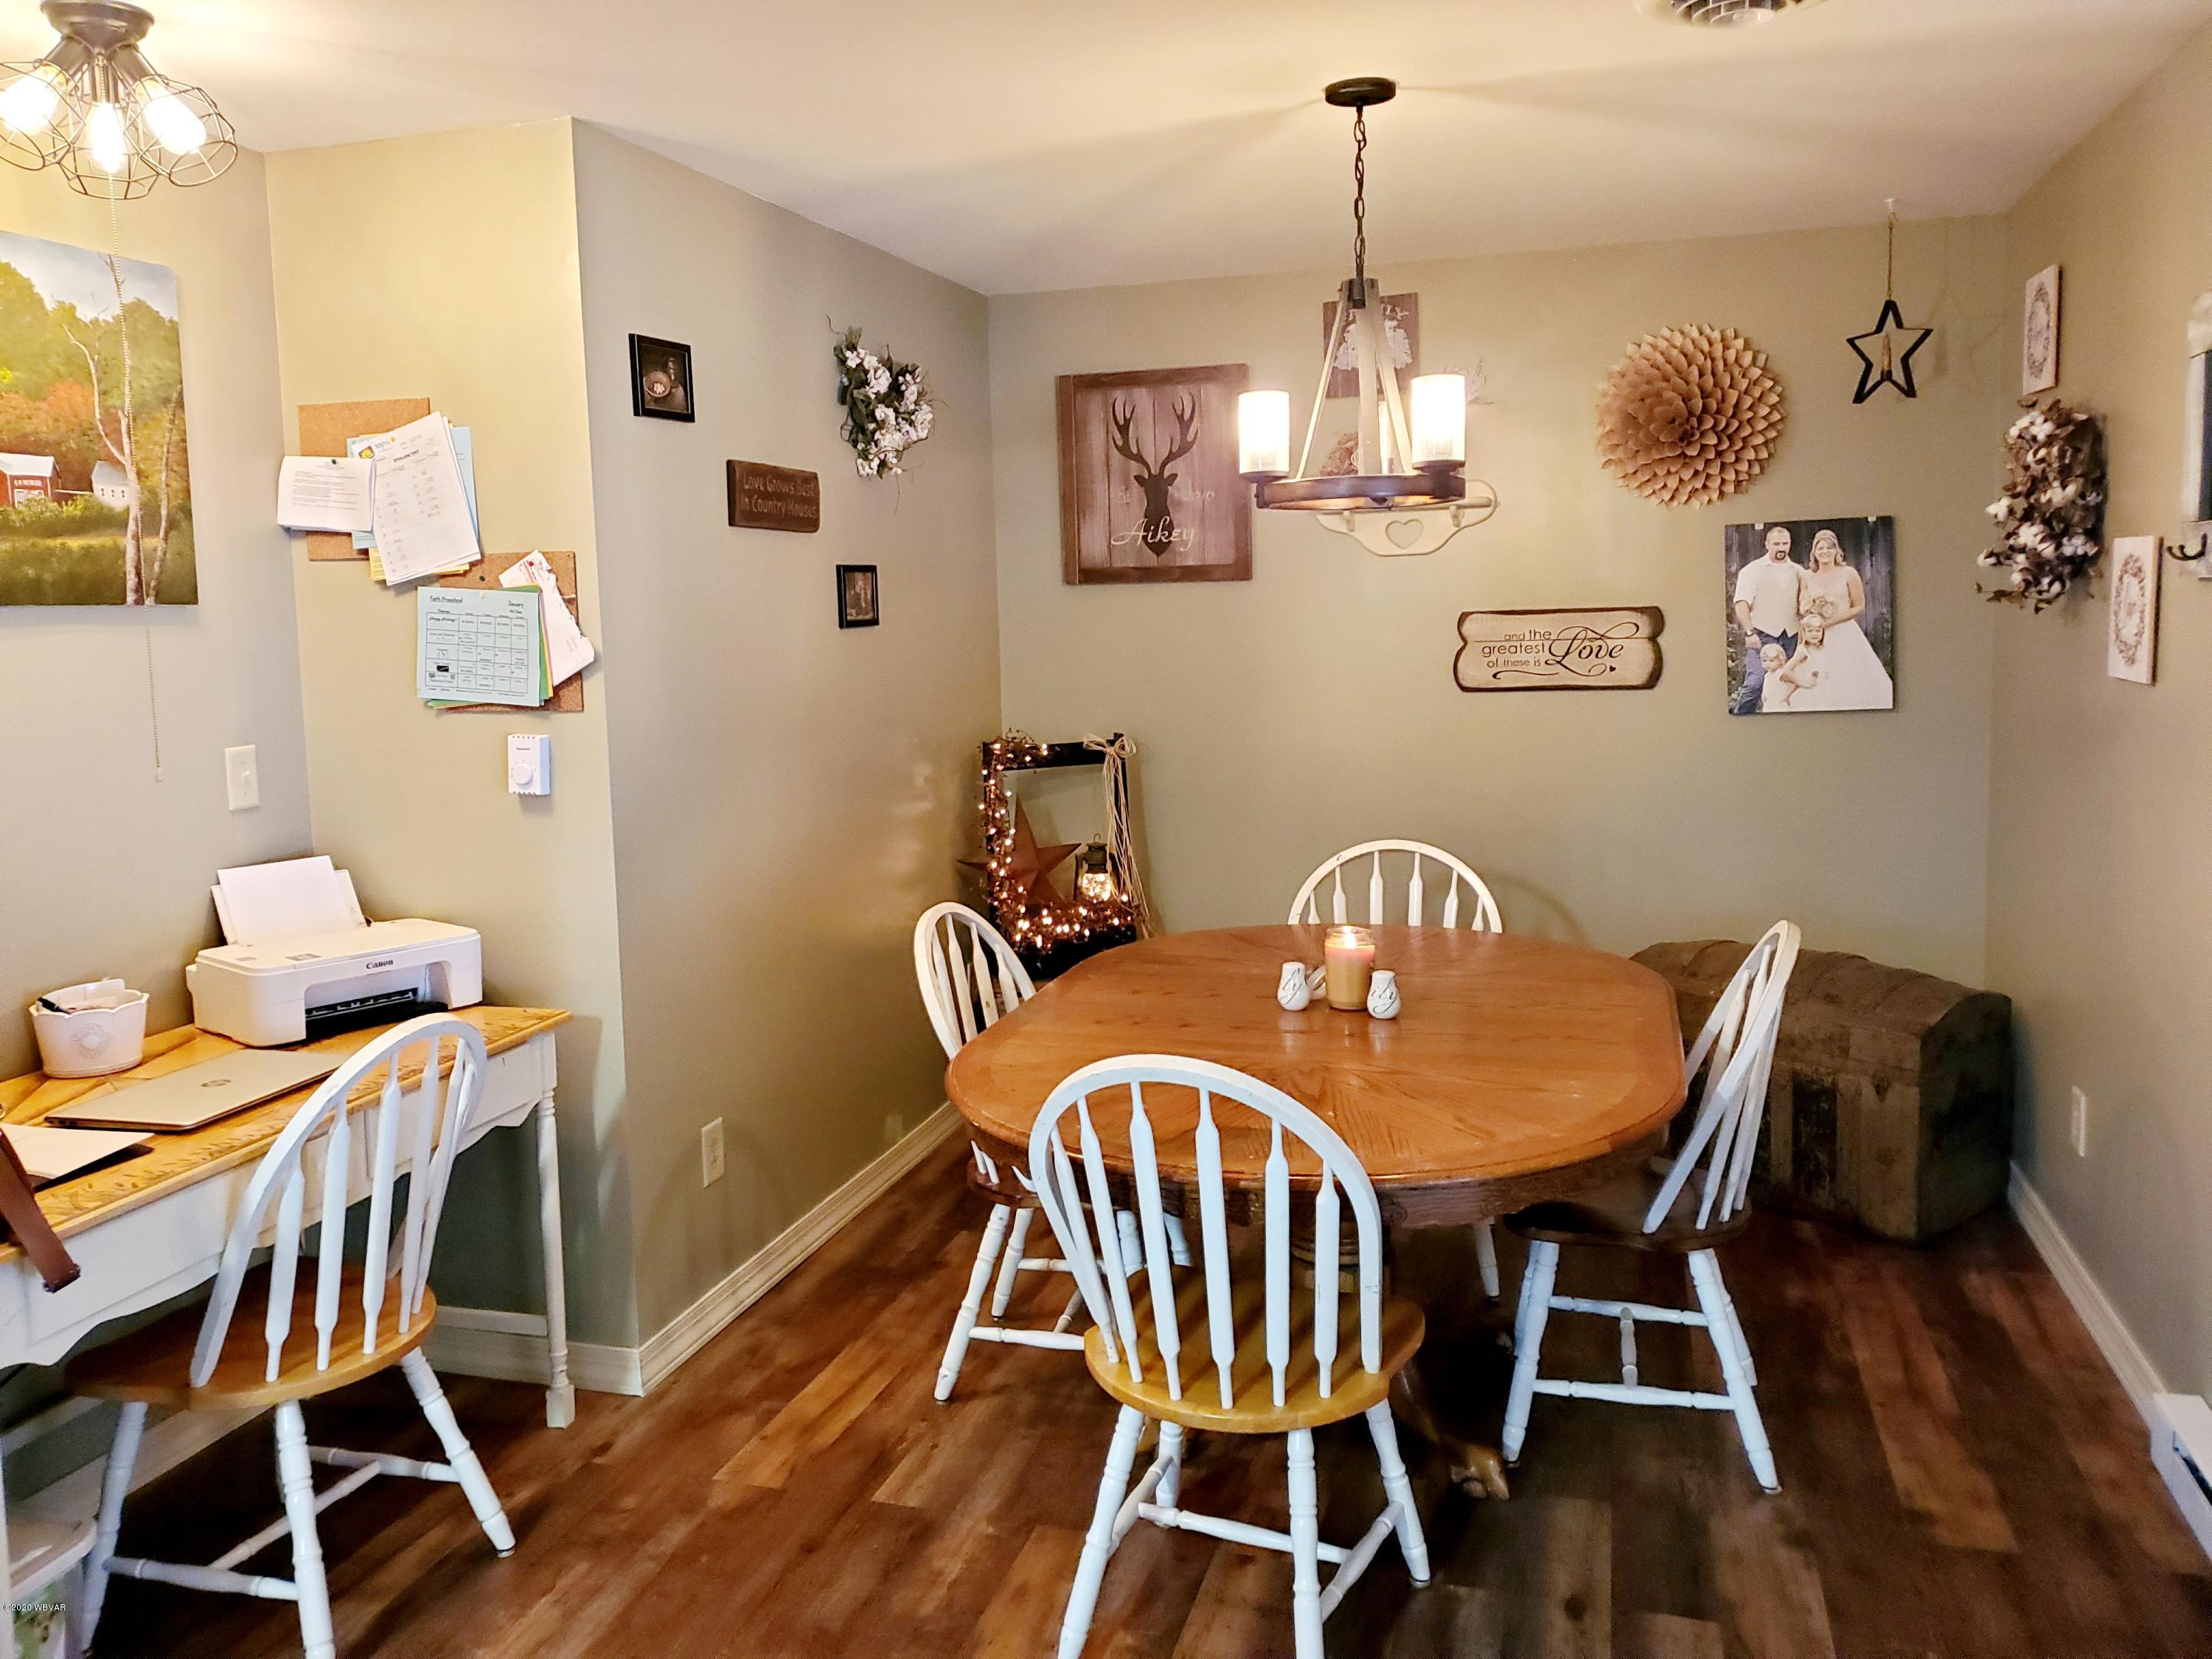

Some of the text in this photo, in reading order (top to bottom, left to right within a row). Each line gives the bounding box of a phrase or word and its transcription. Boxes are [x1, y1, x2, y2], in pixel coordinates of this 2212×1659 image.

[743, 472, 815, 497] Love Grows Best
[752, 494, 785, 517] Country
[788, 500, 817, 518] Houses
[1110, 515, 1194, 552] Aikey
[1503, 628, 1552, 641] and the
[1481, 641, 1545, 658] greatest
[1545, 622, 1640, 677] Love
[1486, 657, 1542, 668] of these is
[366, 959, 394, 970] Canon
